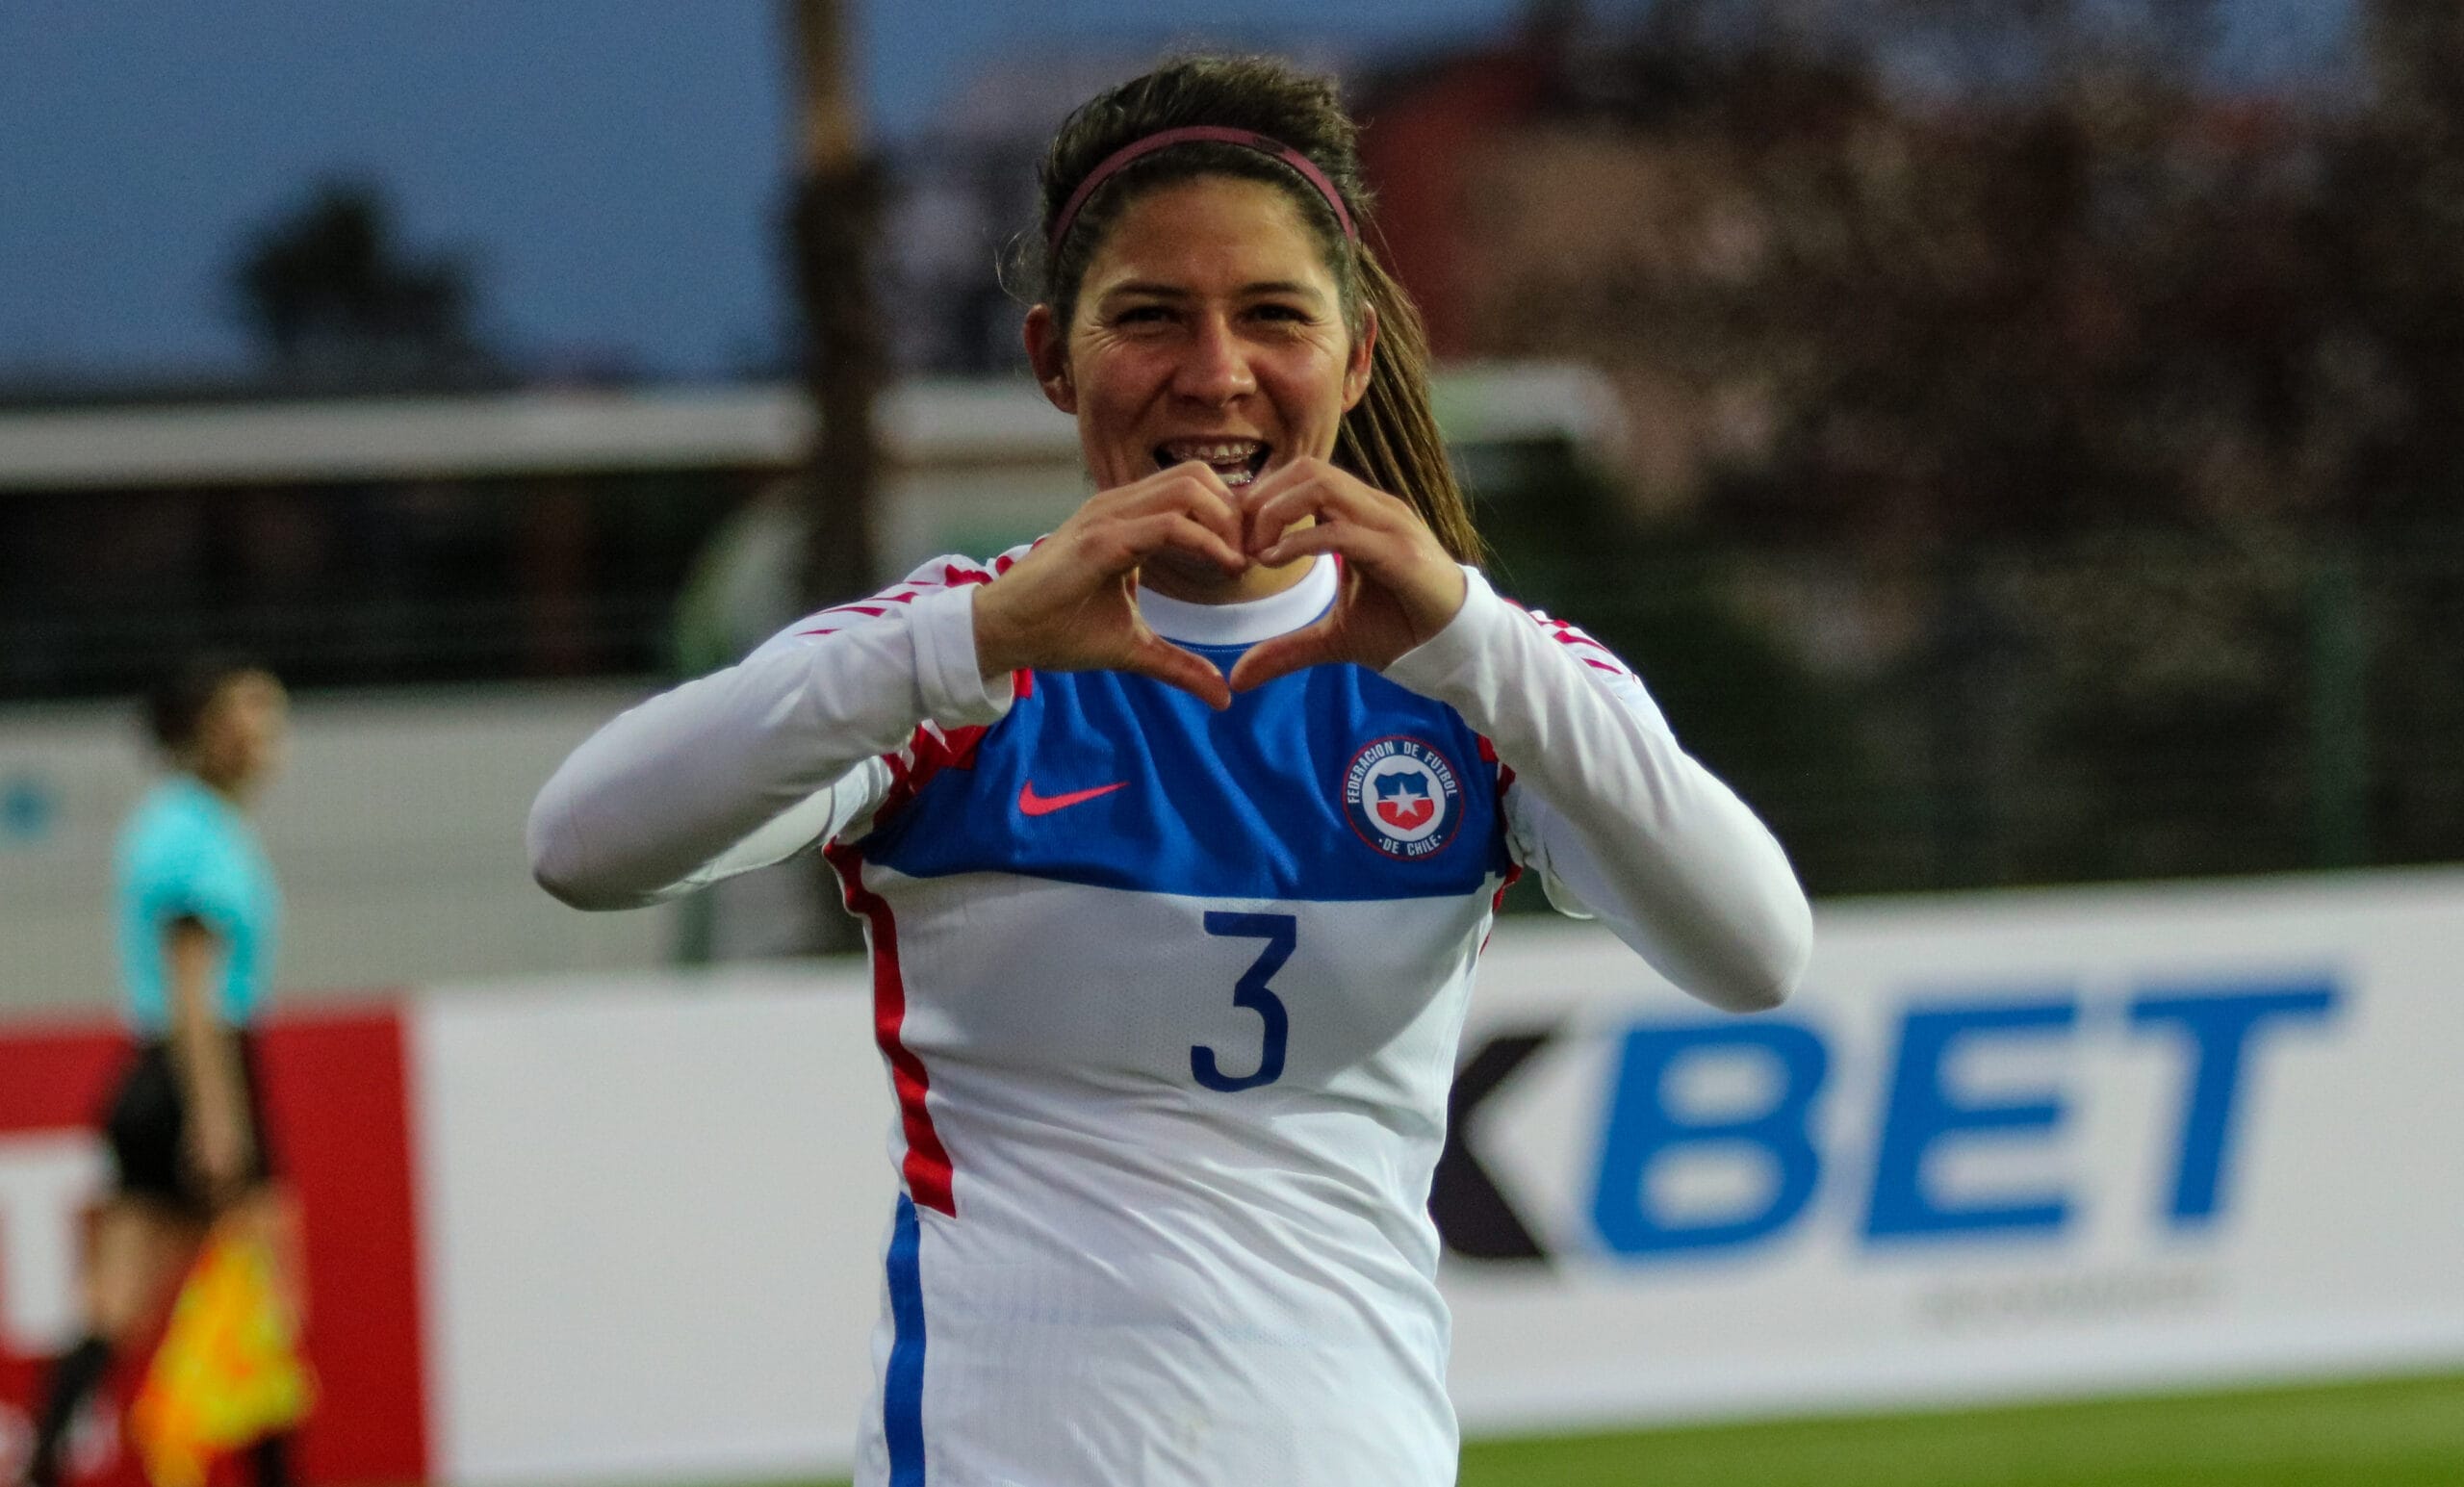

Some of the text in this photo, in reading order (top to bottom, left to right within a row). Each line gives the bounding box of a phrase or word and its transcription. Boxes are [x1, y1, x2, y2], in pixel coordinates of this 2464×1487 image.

[1347, 739, 1458, 805] FEDERACION DE FUTBOL
[1382, 835, 1441, 857] DE CHILE
[1190, 910, 1297, 1093] 3
